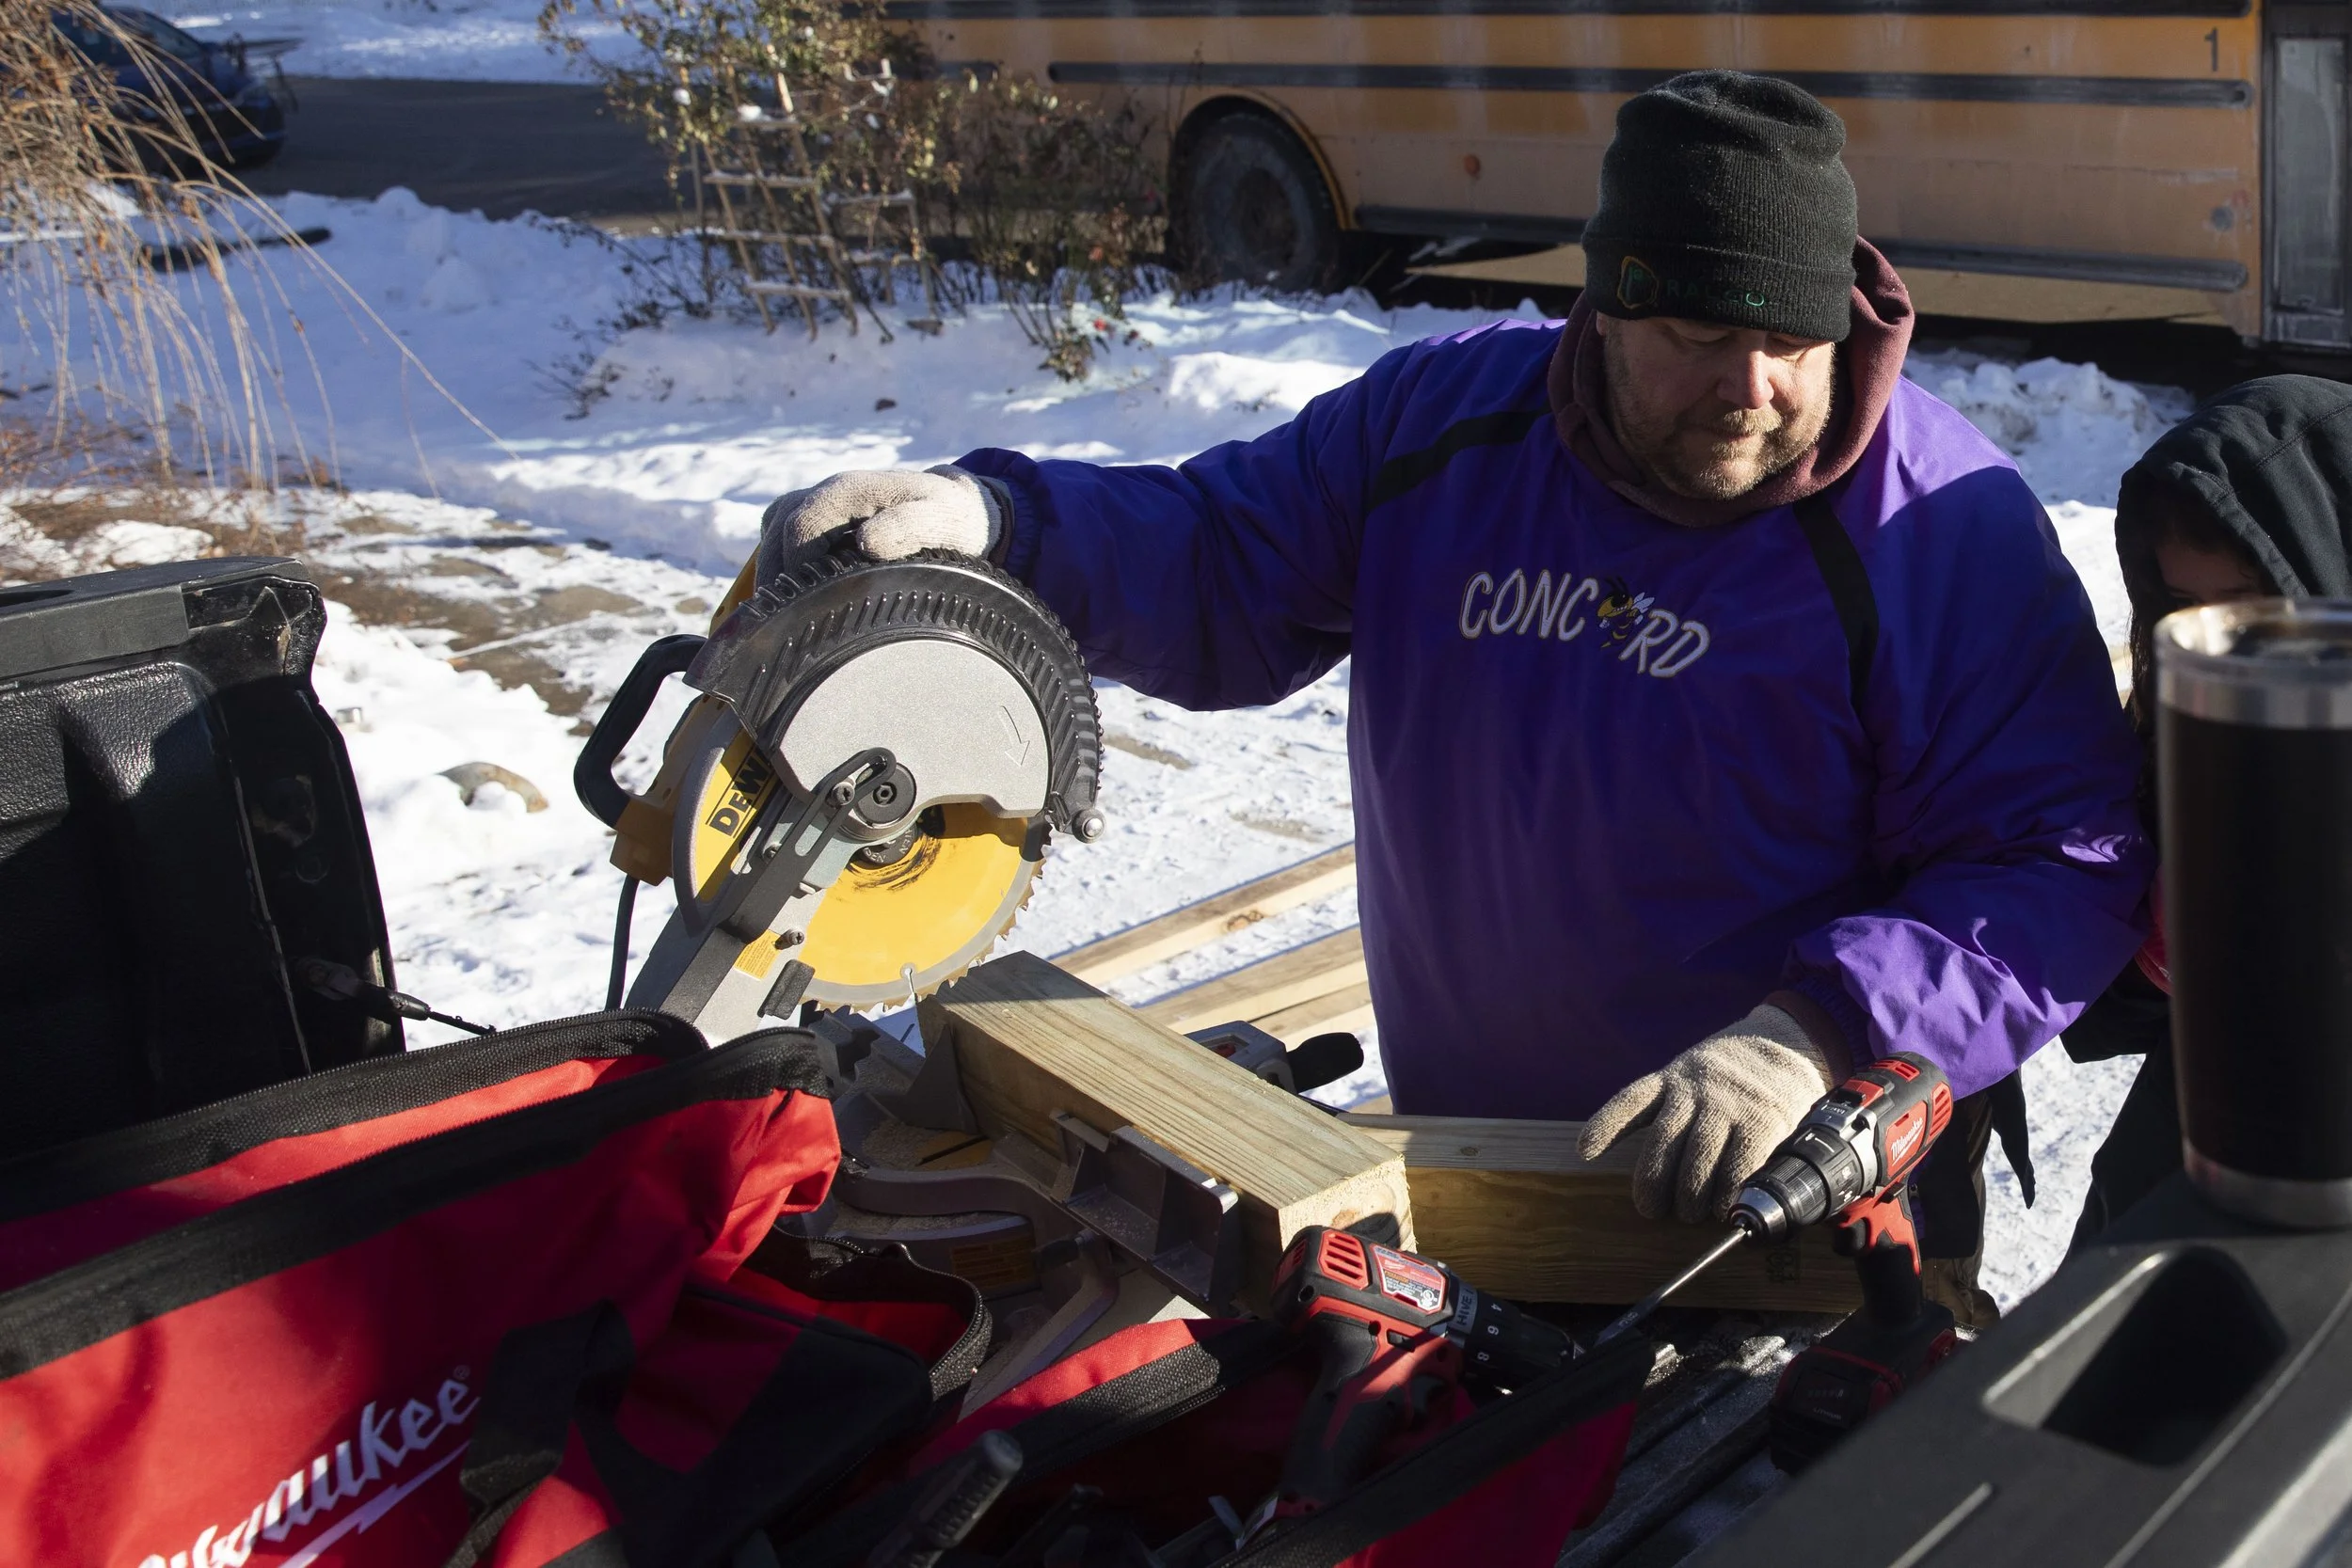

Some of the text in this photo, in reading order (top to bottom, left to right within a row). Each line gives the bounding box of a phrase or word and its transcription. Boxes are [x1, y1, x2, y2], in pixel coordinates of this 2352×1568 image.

[2204, 27, 2218, 71] 1
[1460, 568, 1710, 677] CONCRD
[709, 755, 771, 836] DEW
[1891, 1117, 1923, 1161] Milwaukee
[1457, 1295, 1472, 1325] HIVE
[1477, 1351, 1490, 1361] 8
[138, 1378, 481, 1568] lwaukee
